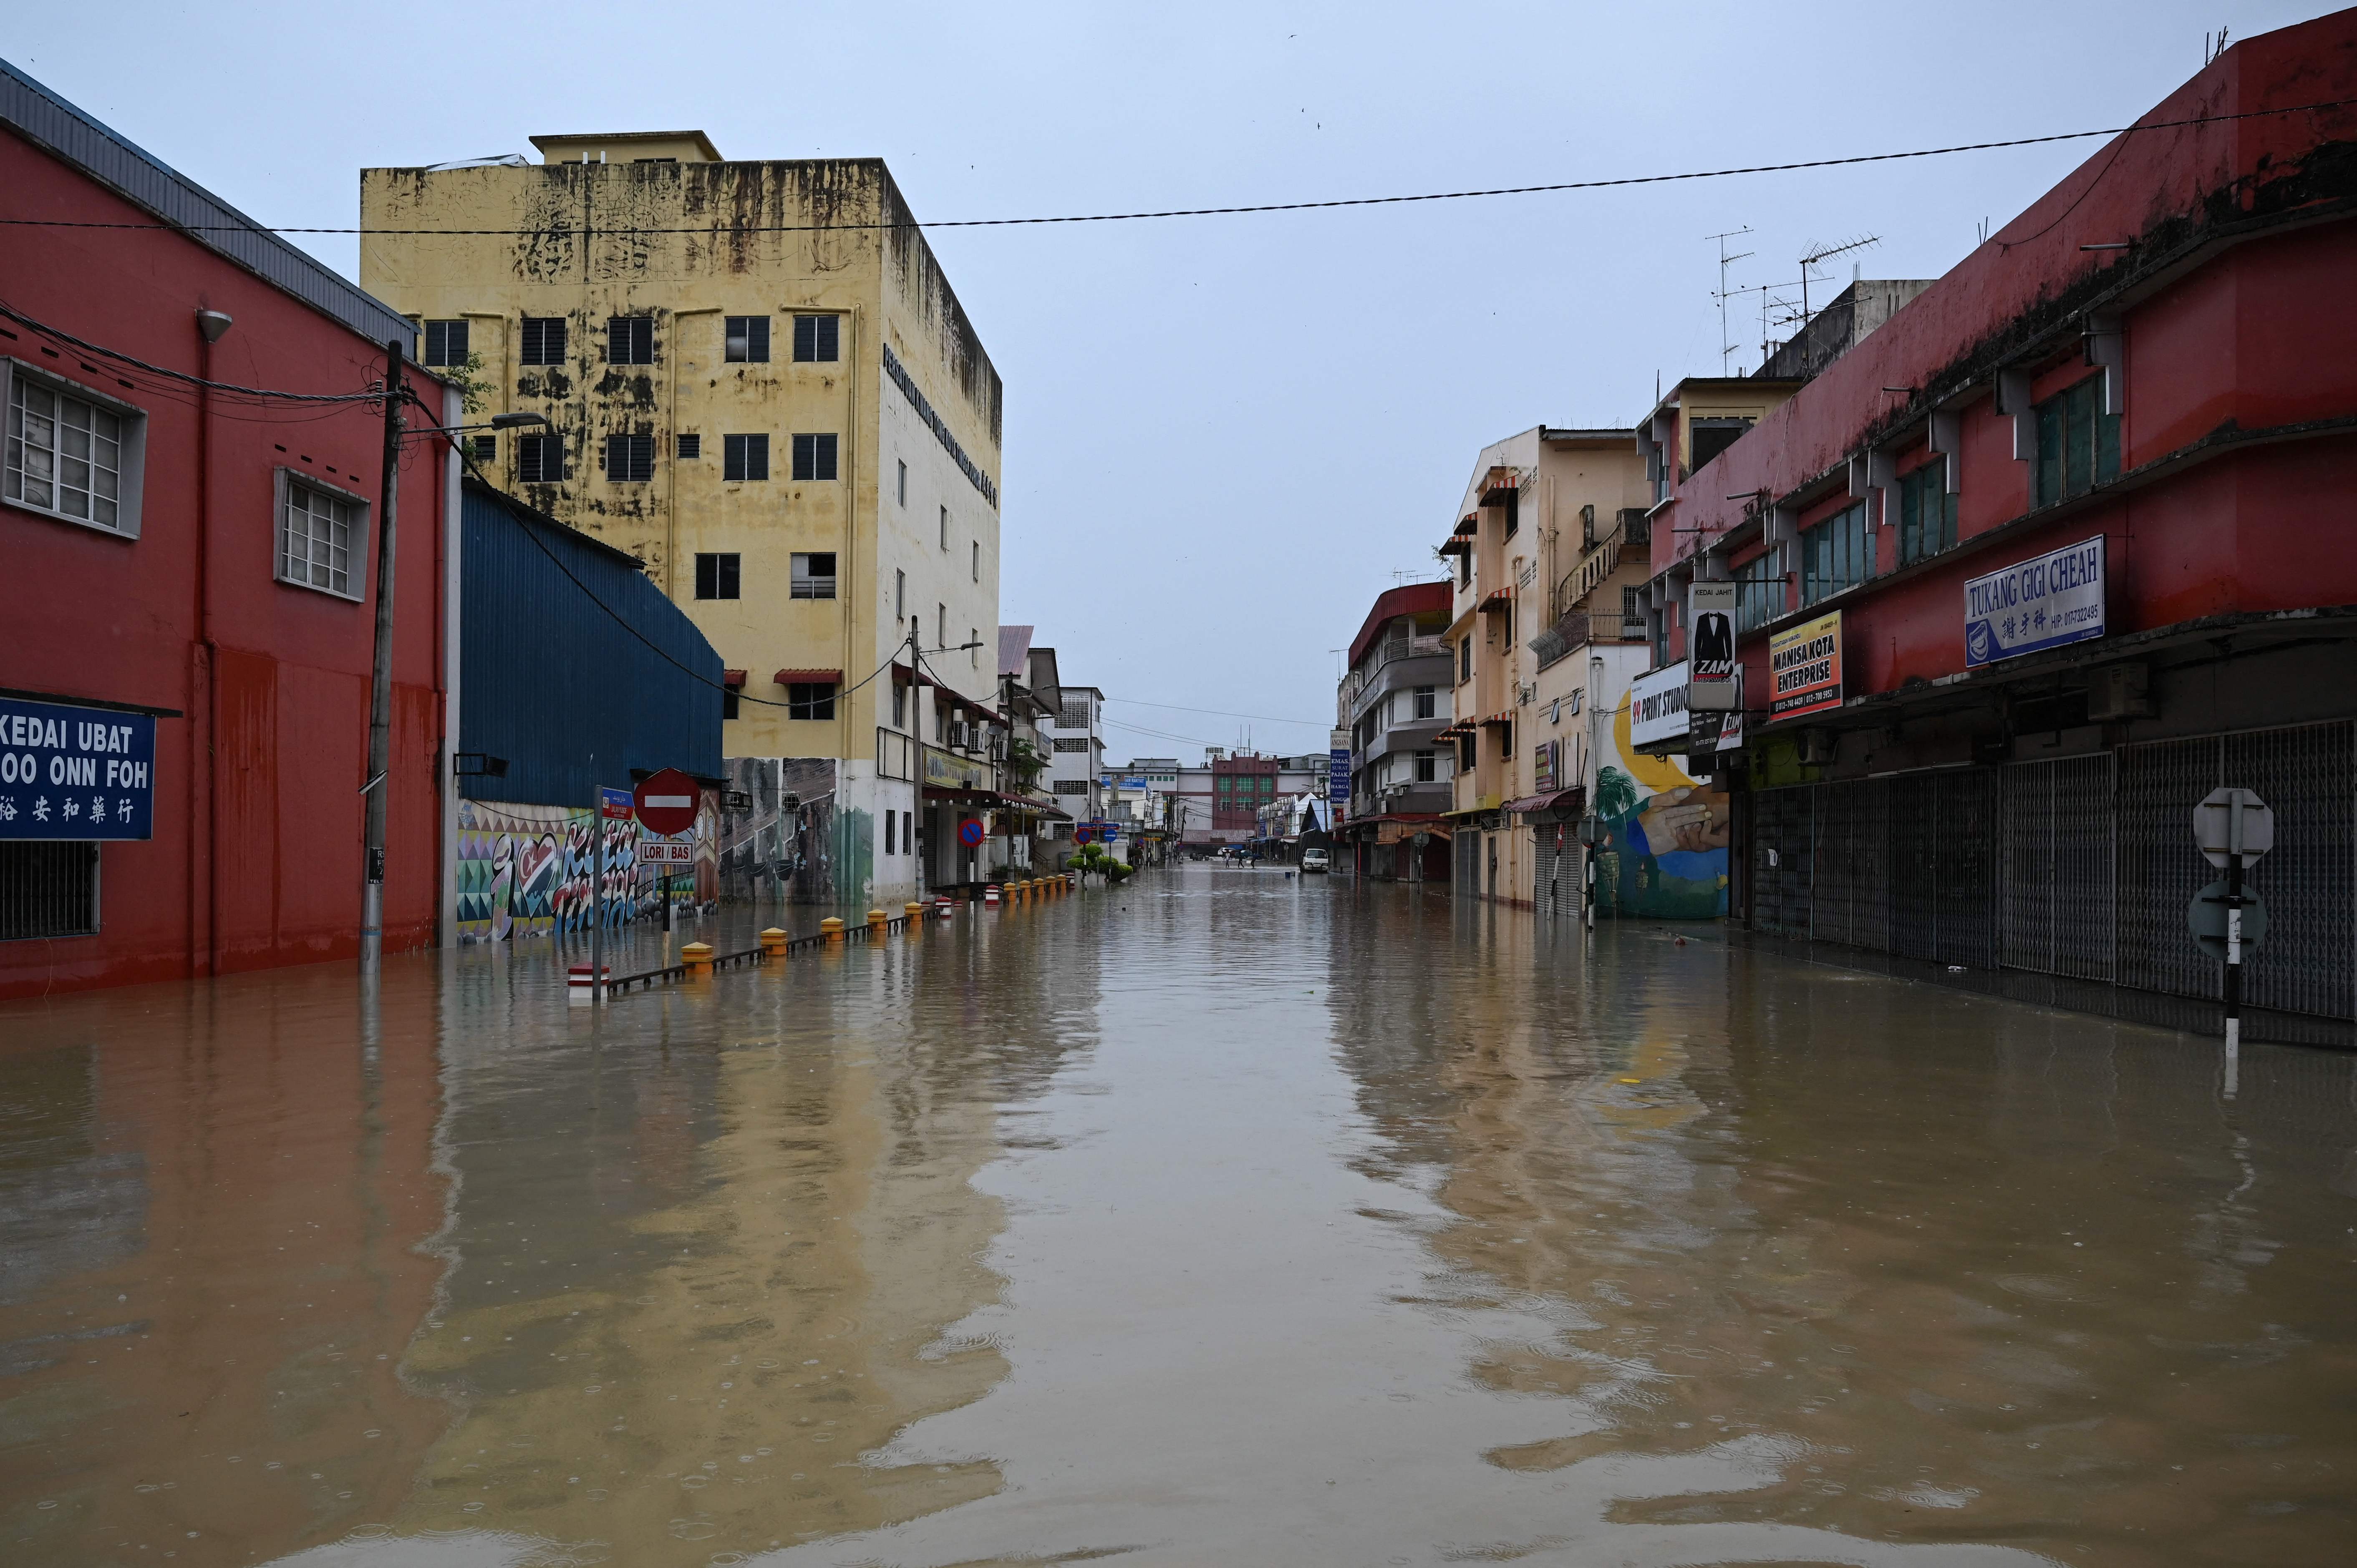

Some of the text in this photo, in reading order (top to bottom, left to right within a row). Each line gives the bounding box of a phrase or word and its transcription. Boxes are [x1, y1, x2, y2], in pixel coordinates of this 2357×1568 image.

[883, 342, 915, 406] PERSATUAN
[915, 387, 932, 428] KWANG
[932, 410, 945, 445] TONG
[945, 427, 955, 459] KOTA
[1970, 546, 2097, 617] TUKANG GIGI CHEAH
[2002, 607, 2047, 639] 謝牙科
[2051, 604, 2097, 629] H/P: 017-7322495
[1697, 660, 1732, 674] ZAM
[1774, 634, 1835, 672] MANISA KOTA
[1778, 659, 1830, 693] ENTERPRISE
[1633, 683, 1688, 725] 99 PRINT STUDIO
[1779, 689, 1833, 710] 012-748 4439 012-700 5953
[78, 722, 133, 754] UBAT
[1728, 714, 1741, 730] ZAM
[50, 755, 96, 786] ONN
[107, 760, 147, 788] FOH
[645, 846, 664, 859] LORI
[671, 846, 688, 859] BAS
